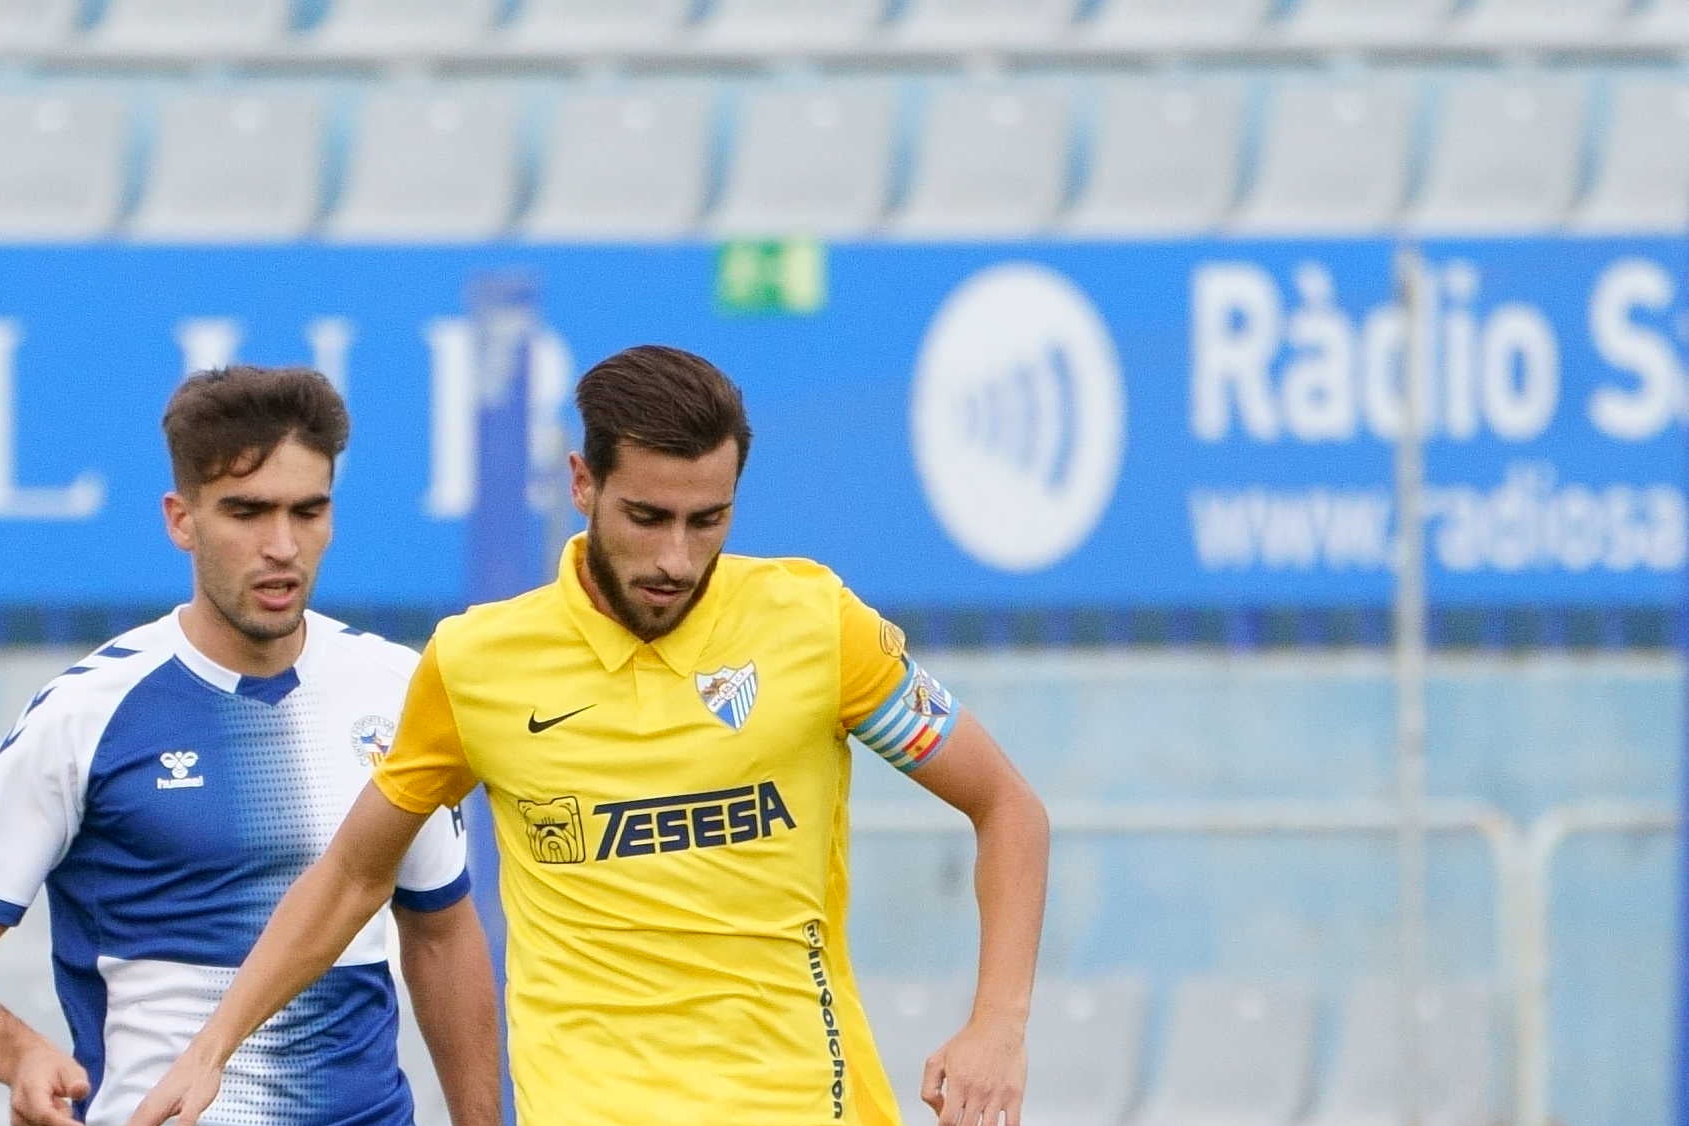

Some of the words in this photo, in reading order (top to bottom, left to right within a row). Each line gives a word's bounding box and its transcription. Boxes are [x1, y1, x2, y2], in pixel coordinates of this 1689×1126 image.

[1193, 260, 1559, 442] Ràdio
[1586, 258, 1688, 442] S
[592, 781, 797, 862] TESESA
